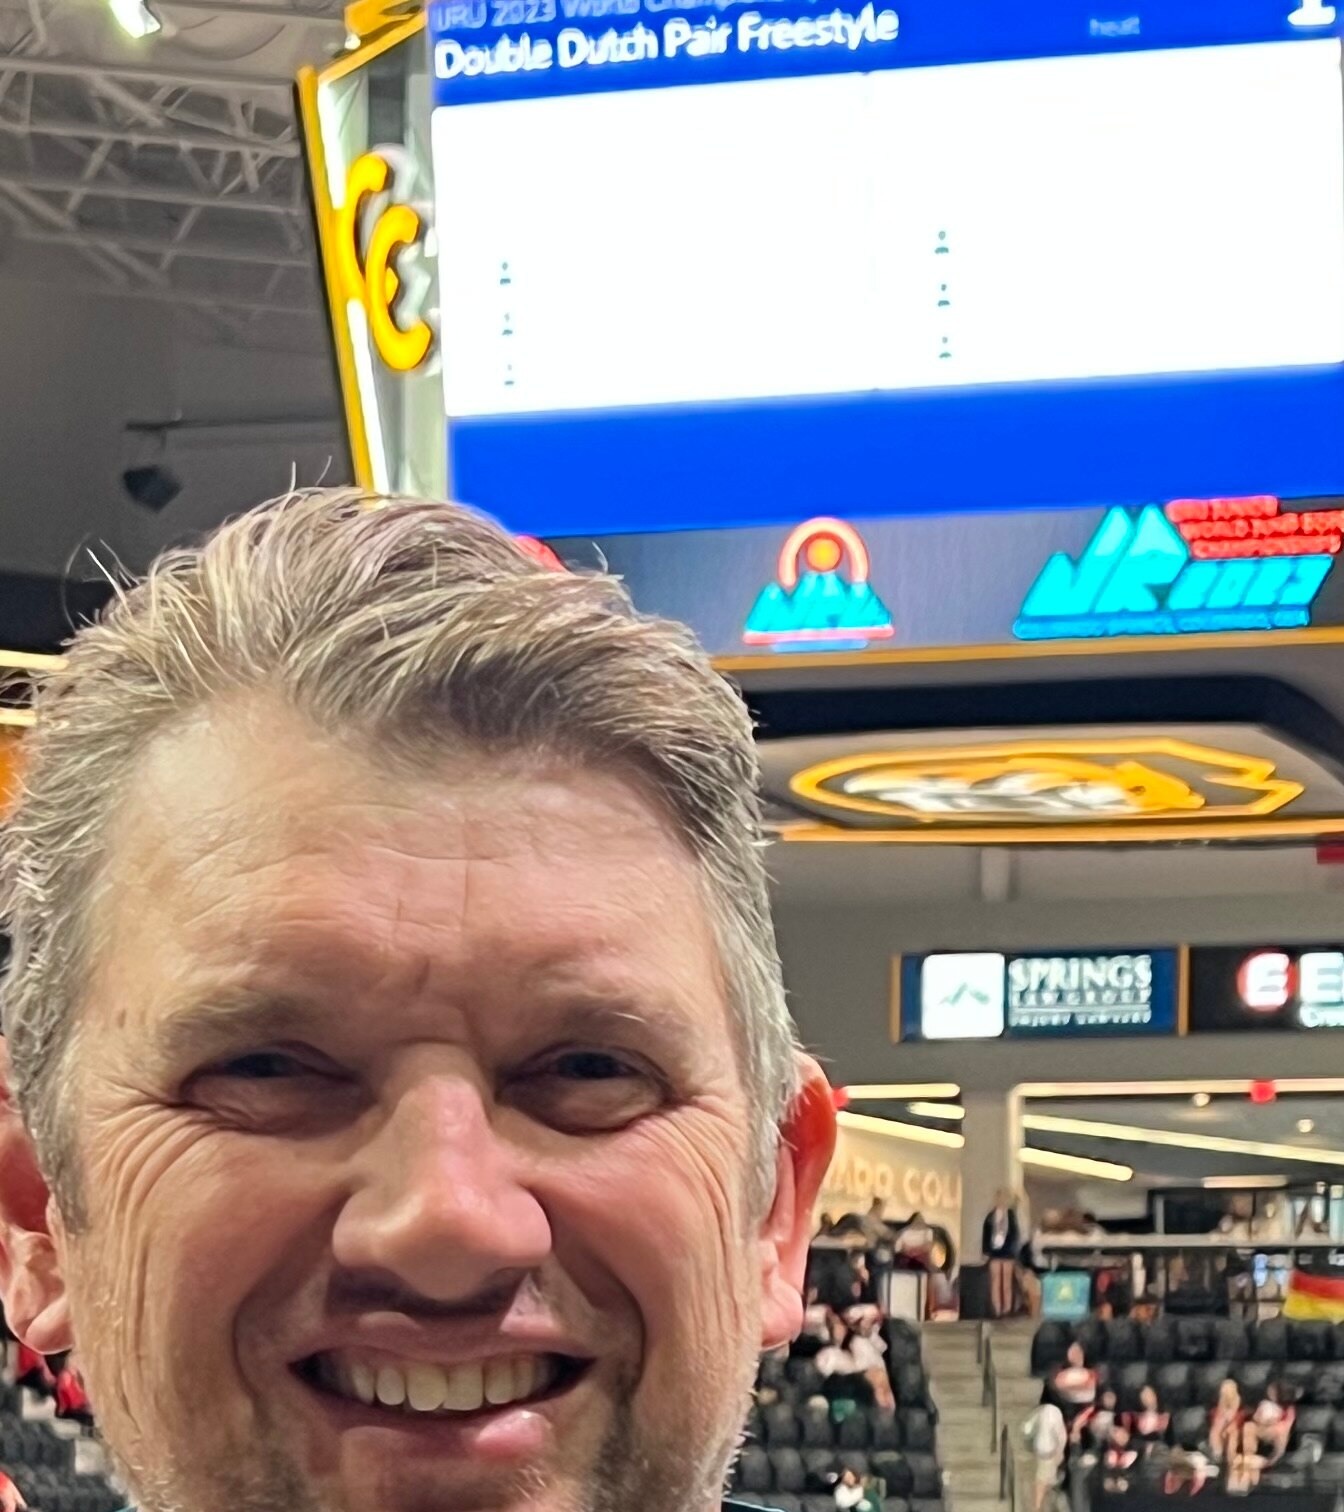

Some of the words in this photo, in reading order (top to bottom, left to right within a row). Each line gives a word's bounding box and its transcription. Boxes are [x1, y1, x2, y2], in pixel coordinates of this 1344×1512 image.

[433, 33, 553, 79] Double
[557, 22, 659, 68] Dutch
[664, 16, 733, 58] Pair
[737, 2, 901, 53] Freestyle
[1008, 955, 1152, 992] SPRINGS
